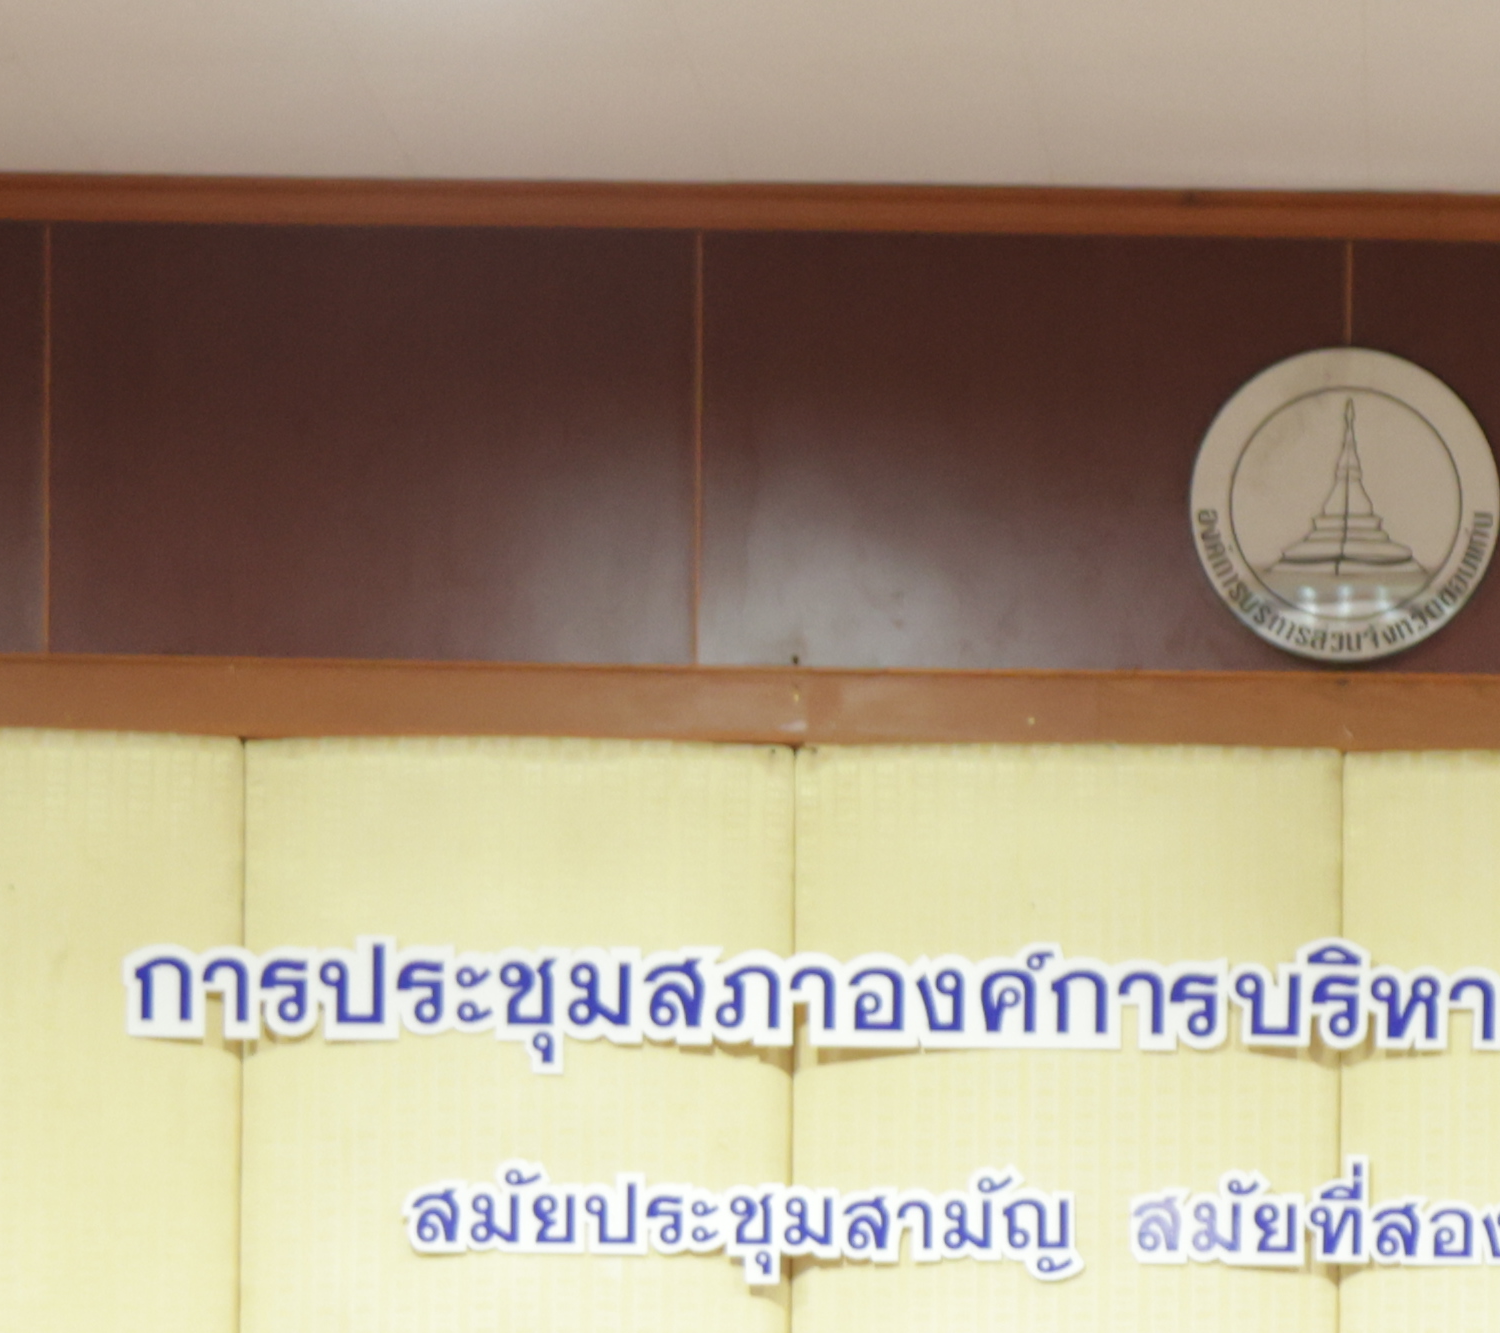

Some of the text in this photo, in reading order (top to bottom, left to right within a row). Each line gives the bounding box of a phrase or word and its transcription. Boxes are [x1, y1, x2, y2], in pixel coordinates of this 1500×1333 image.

[410, 1168, 1073, 1276] สมัยประชุมสามัญ
